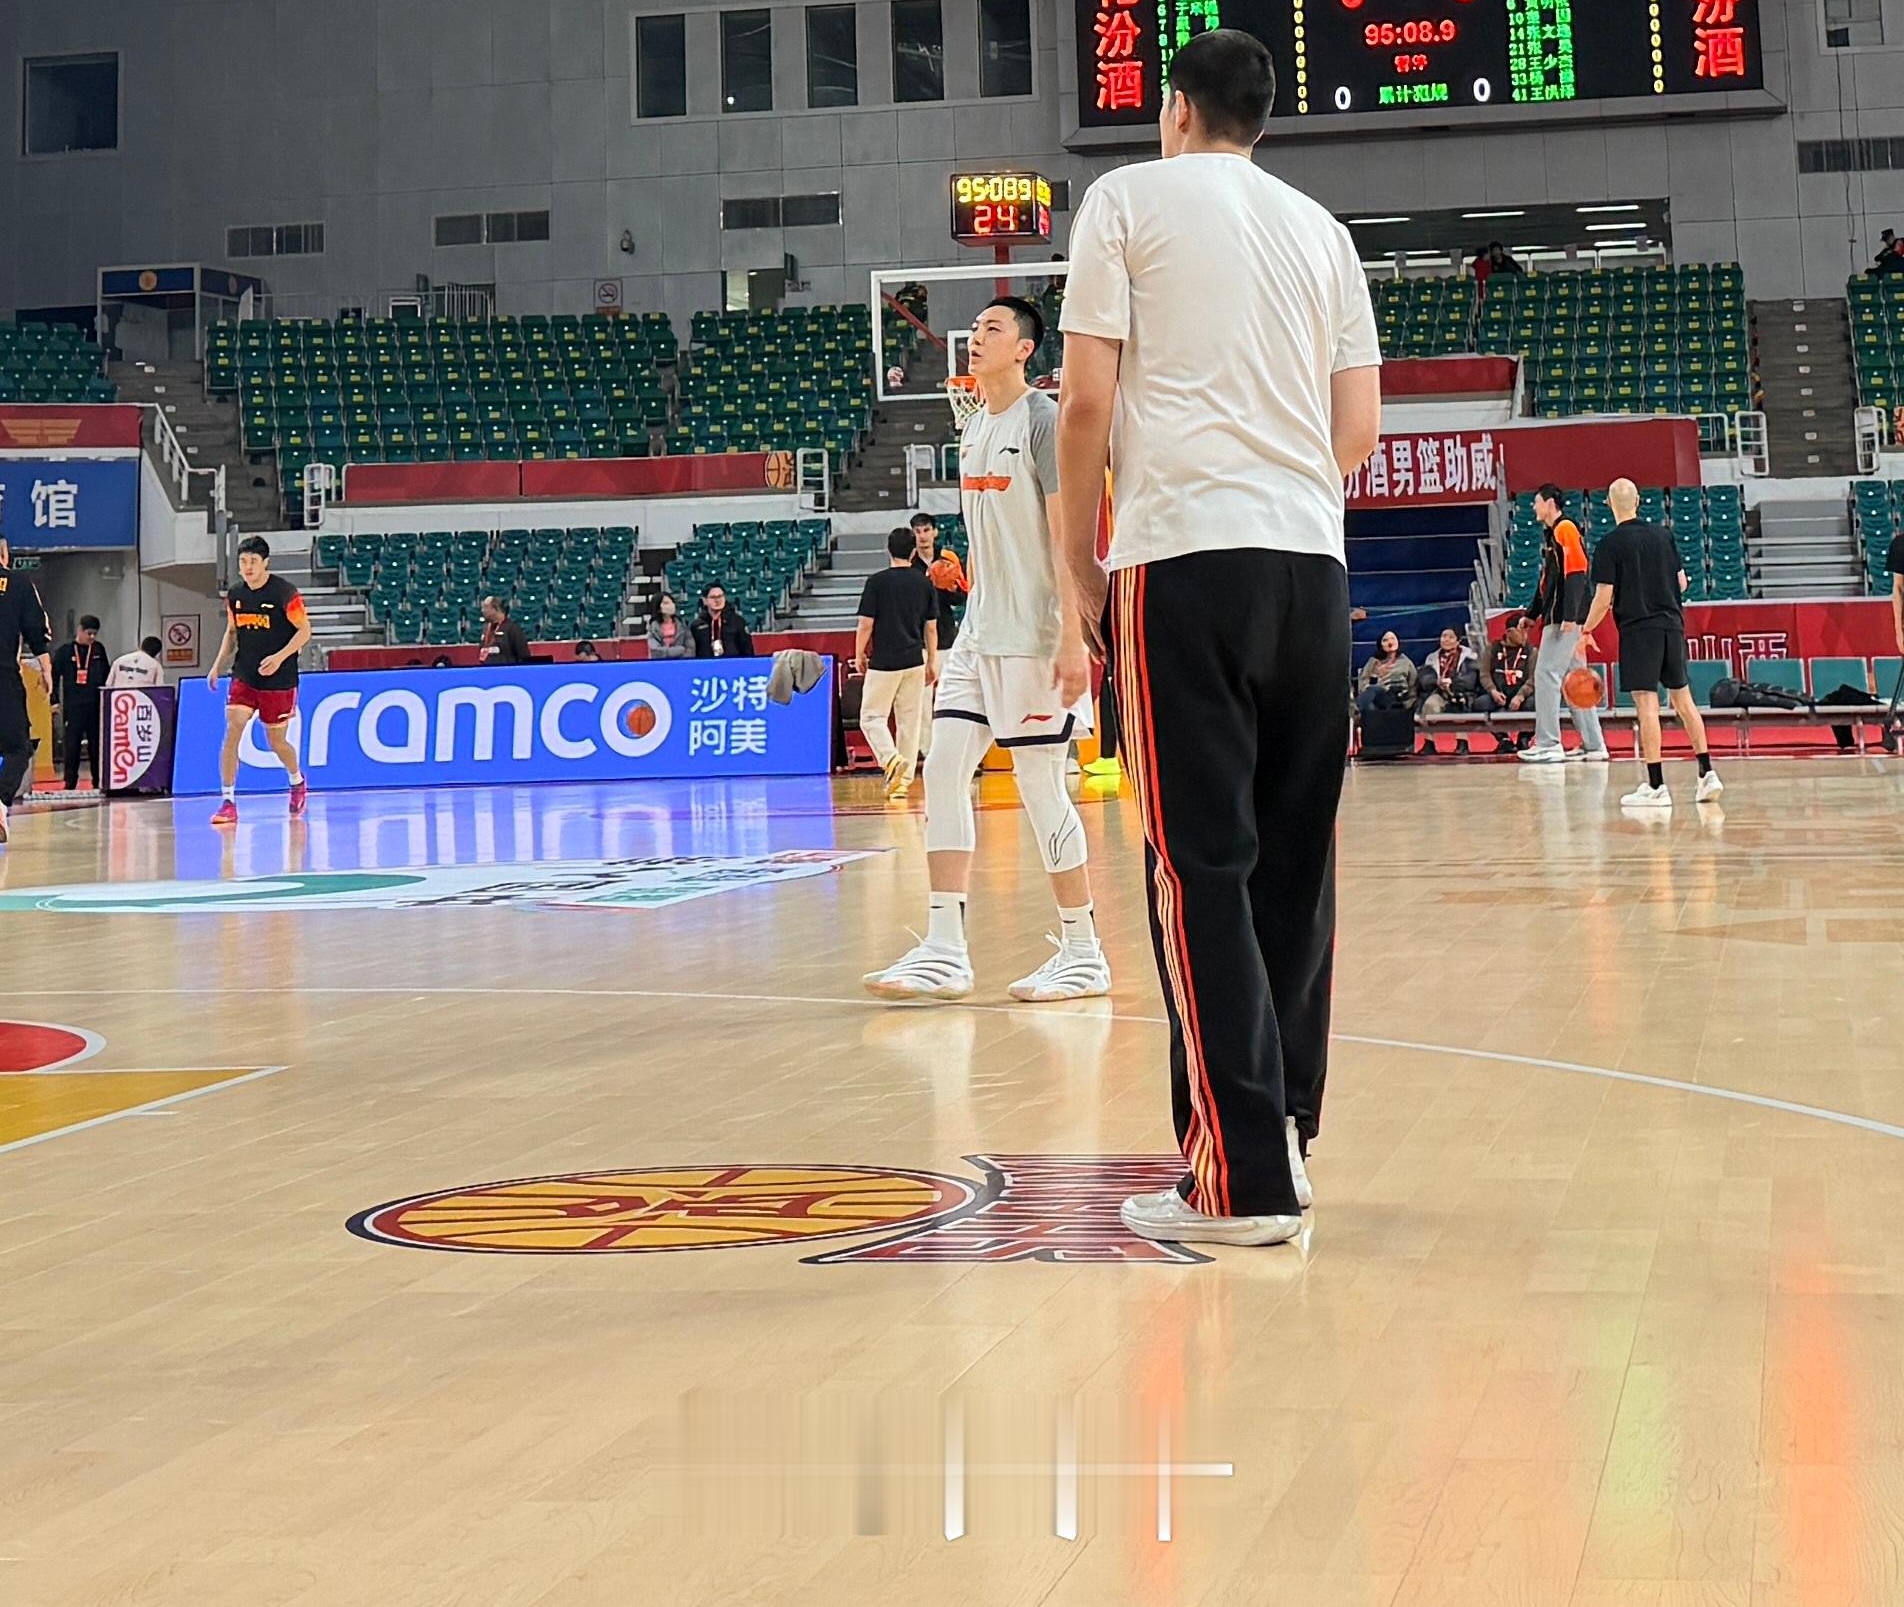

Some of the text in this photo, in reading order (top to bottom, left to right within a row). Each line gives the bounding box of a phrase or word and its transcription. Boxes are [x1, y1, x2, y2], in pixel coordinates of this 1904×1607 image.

[1157, 4, 1166, 16] 6
[1158, 19, 1167, 31] 7
[1508, 12, 1524, 25] 10
[1365, 19, 1456, 46] 95:08.9
[1509, 27, 1525, 40] 14
[1509, 43, 1525, 55] 21
[1509, 58, 1526, 71] 28
[1511, 73, 1527, 85] 33
[1334, 86, 1352, 111] 0
[1473, 78, 1491, 103] 0
[1512, 88, 1527, 101] 41
[973, 205, 1016, 234] 24
[690, 675, 769, 713] 沙特
[689, 718, 768, 757] 阿美
